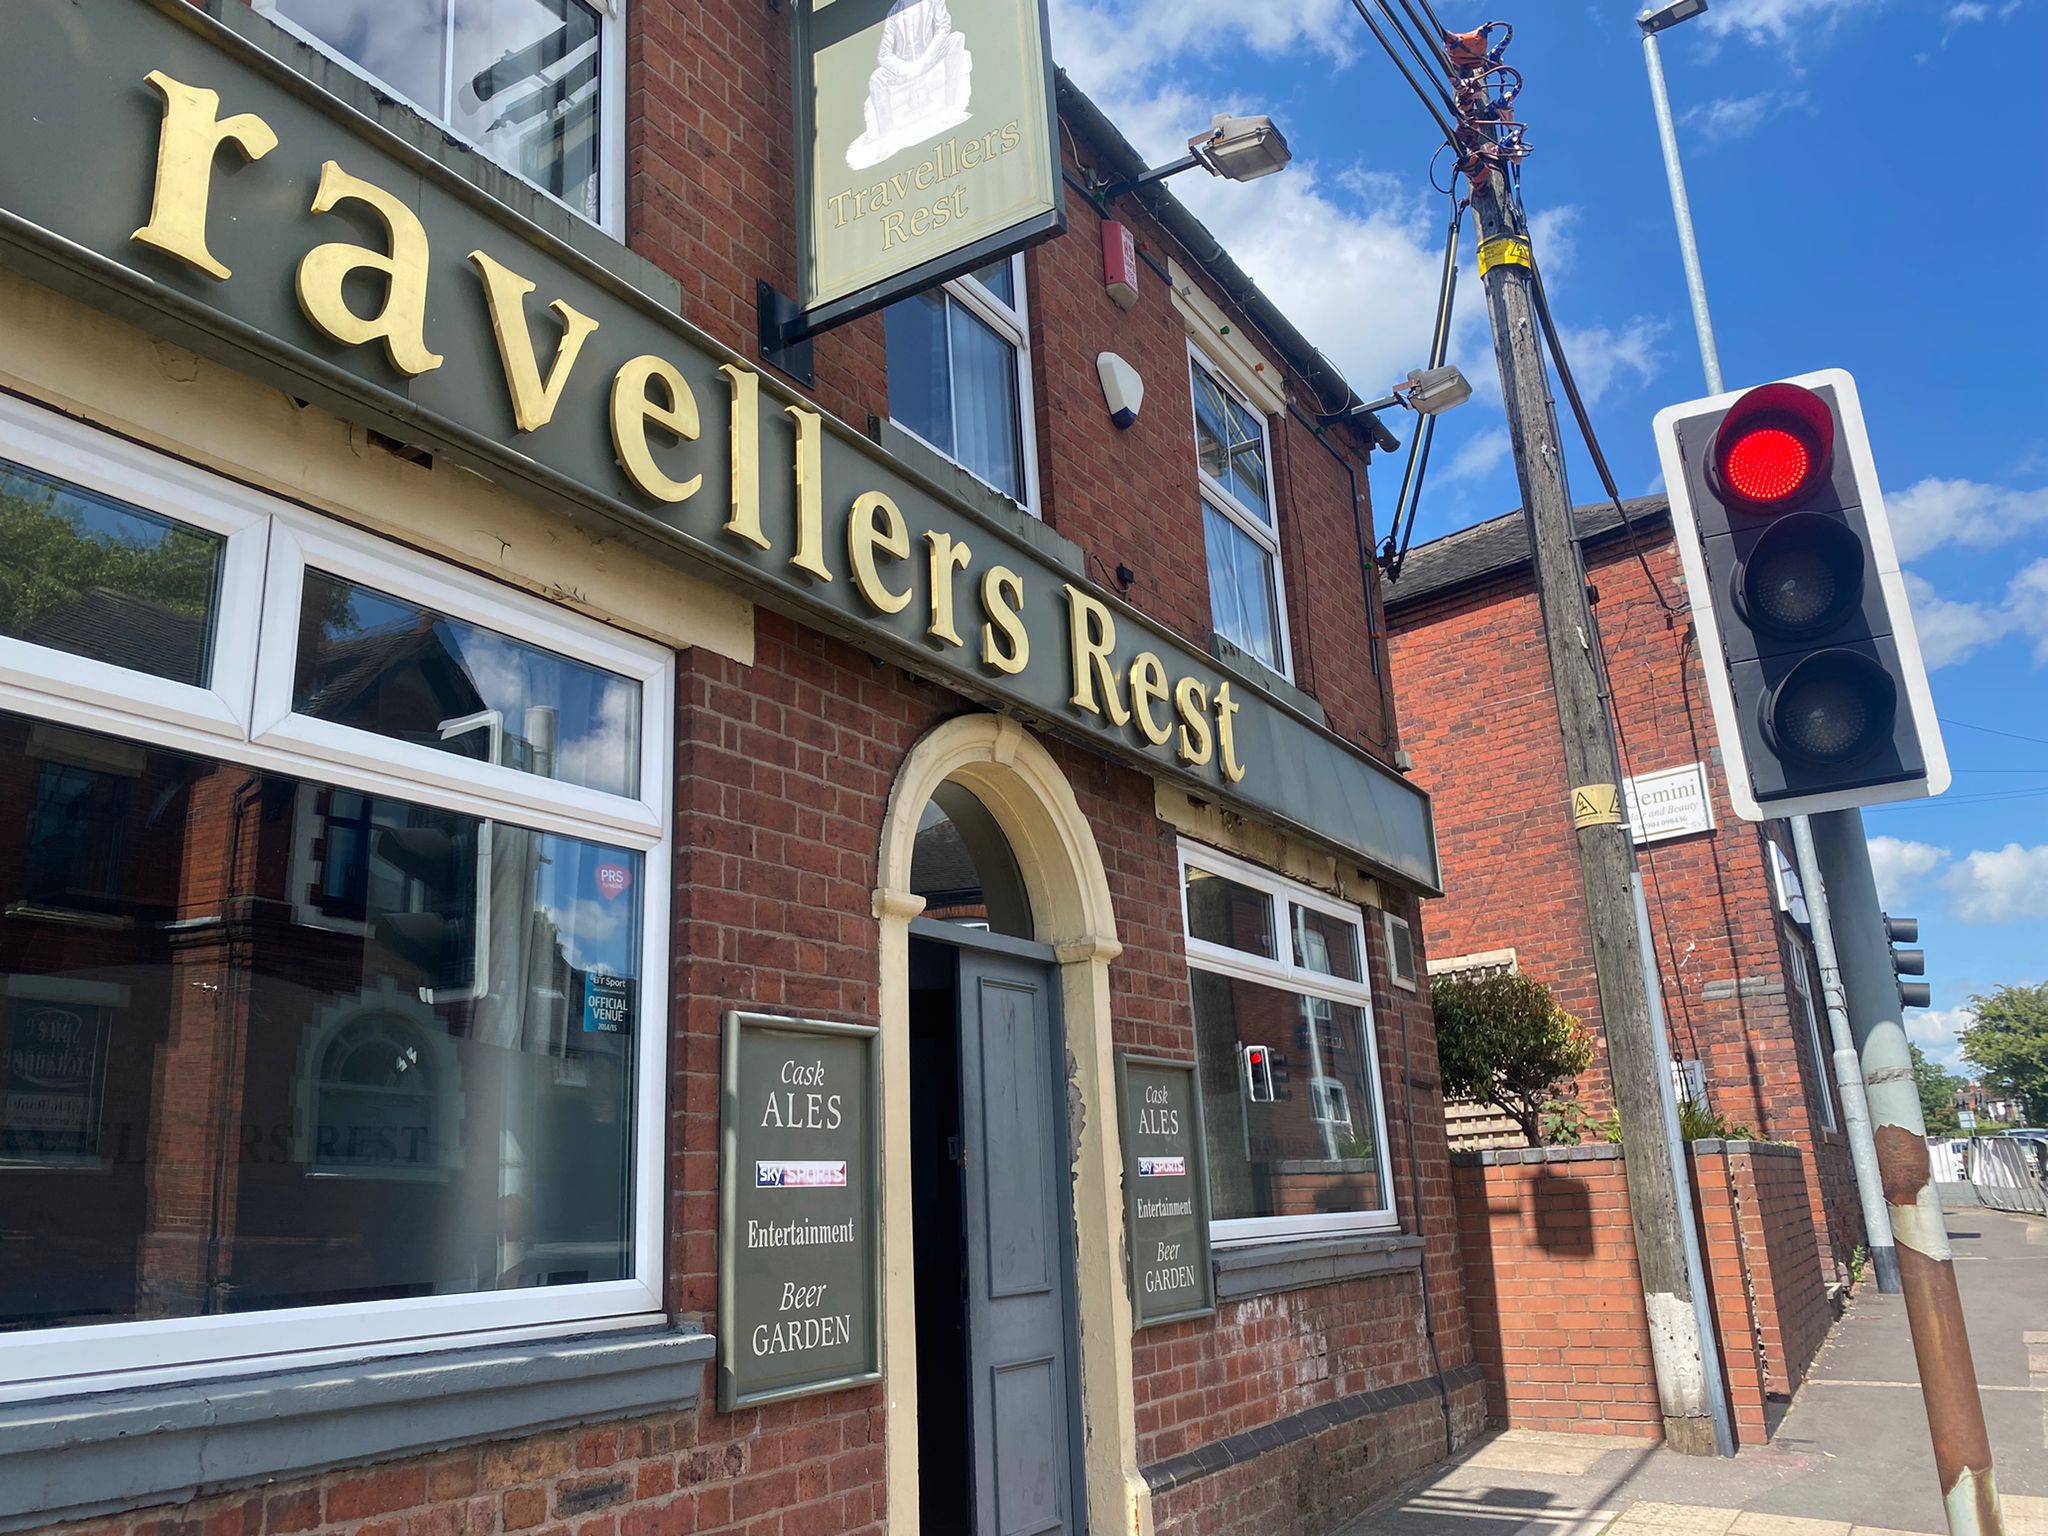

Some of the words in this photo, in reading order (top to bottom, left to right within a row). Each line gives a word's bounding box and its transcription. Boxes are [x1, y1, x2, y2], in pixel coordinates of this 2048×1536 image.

[827, 119, 1022, 229] Travellers
[879, 184, 969, 252] Rest
[130, 69, 1031, 675] ravellers
[1061, 583, 1246, 784] Rest
[1648, 806, 1666, 818] and
[1667, 802, 1698, 814] Beauty
[601, 869, 625, 883] PRS
[593, 976, 605, 985] BT
[606, 976, 626, 989] Sport
[588, 995, 628, 1011] OFFICIAL
[592, 1007, 624, 1022] VENUE
[780, 1059, 825, 1087] Cask
[1145, 1085, 1169, 1105] Cask
[760, 1090, 842, 1130] ALES
[1138, 1108, 1180, 1136] ALES
[758, 1165, 784, 1187] sky
[785, 1167, 845, 1185] SPORTS
[1153, 1162, 1185, 1175] SPORTS
[1137, 1197, 1193, 1219] Entertainment
[748, 1217, 855, 1248] Entertainment
[1157, 1241, 1181, 1262] Beer
[1145, 1264, 1195, 1294] GARDEN
[779, 1281, 827, 1312] Beer
[752, 1314, 850, 1357] GARDEN
